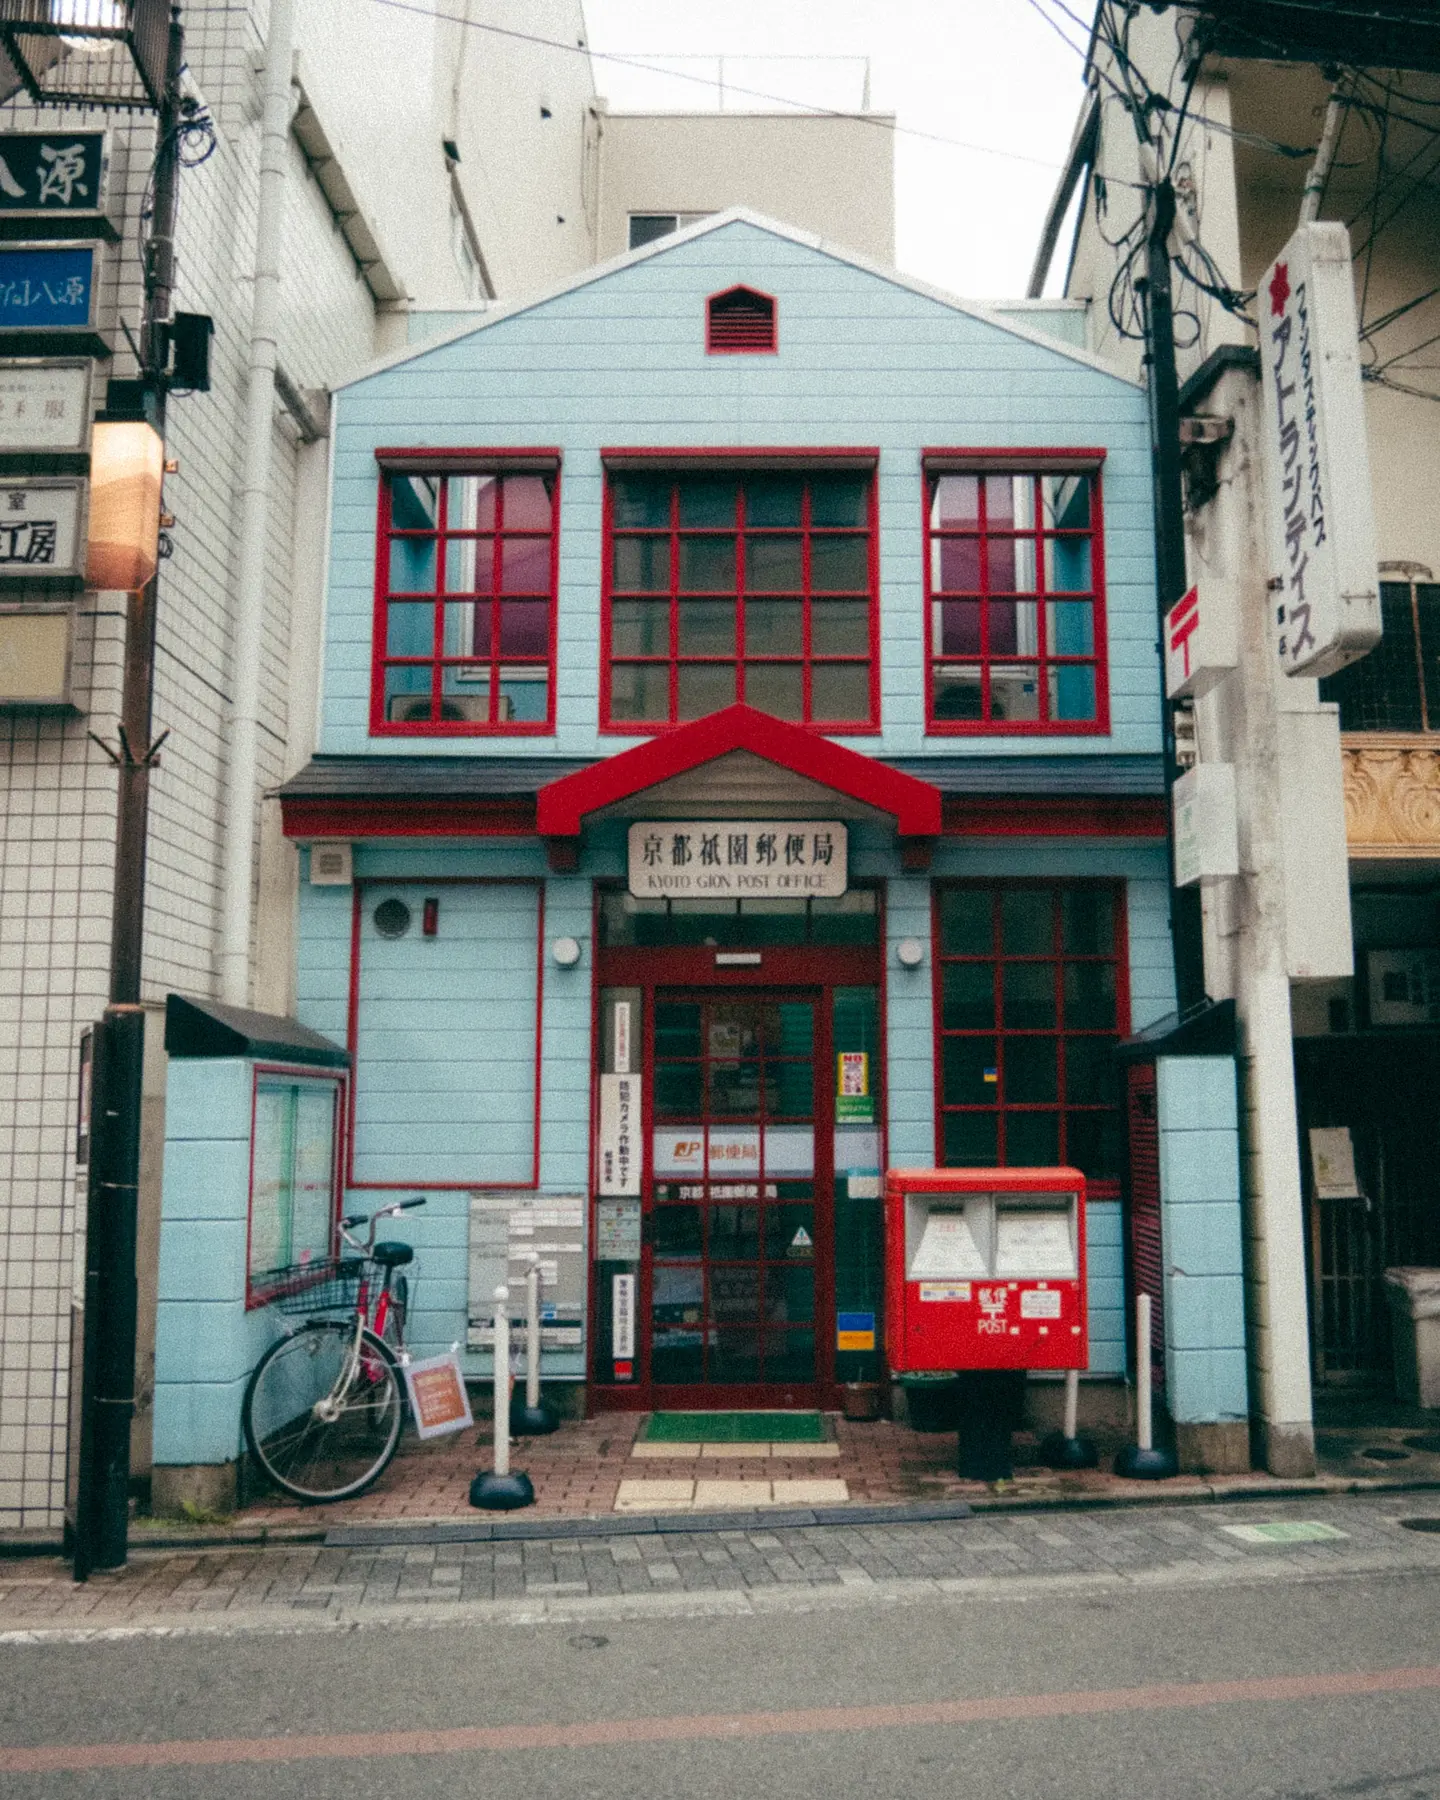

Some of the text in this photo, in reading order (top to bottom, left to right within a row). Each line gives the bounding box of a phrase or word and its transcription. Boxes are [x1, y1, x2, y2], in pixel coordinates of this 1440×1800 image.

[642, 832, 834, 867] 京都祇園郵便局
[648, 874, 826, 889] KYOTO GION POST OFFICE
[978, 1319, 1008, 1335] POST
